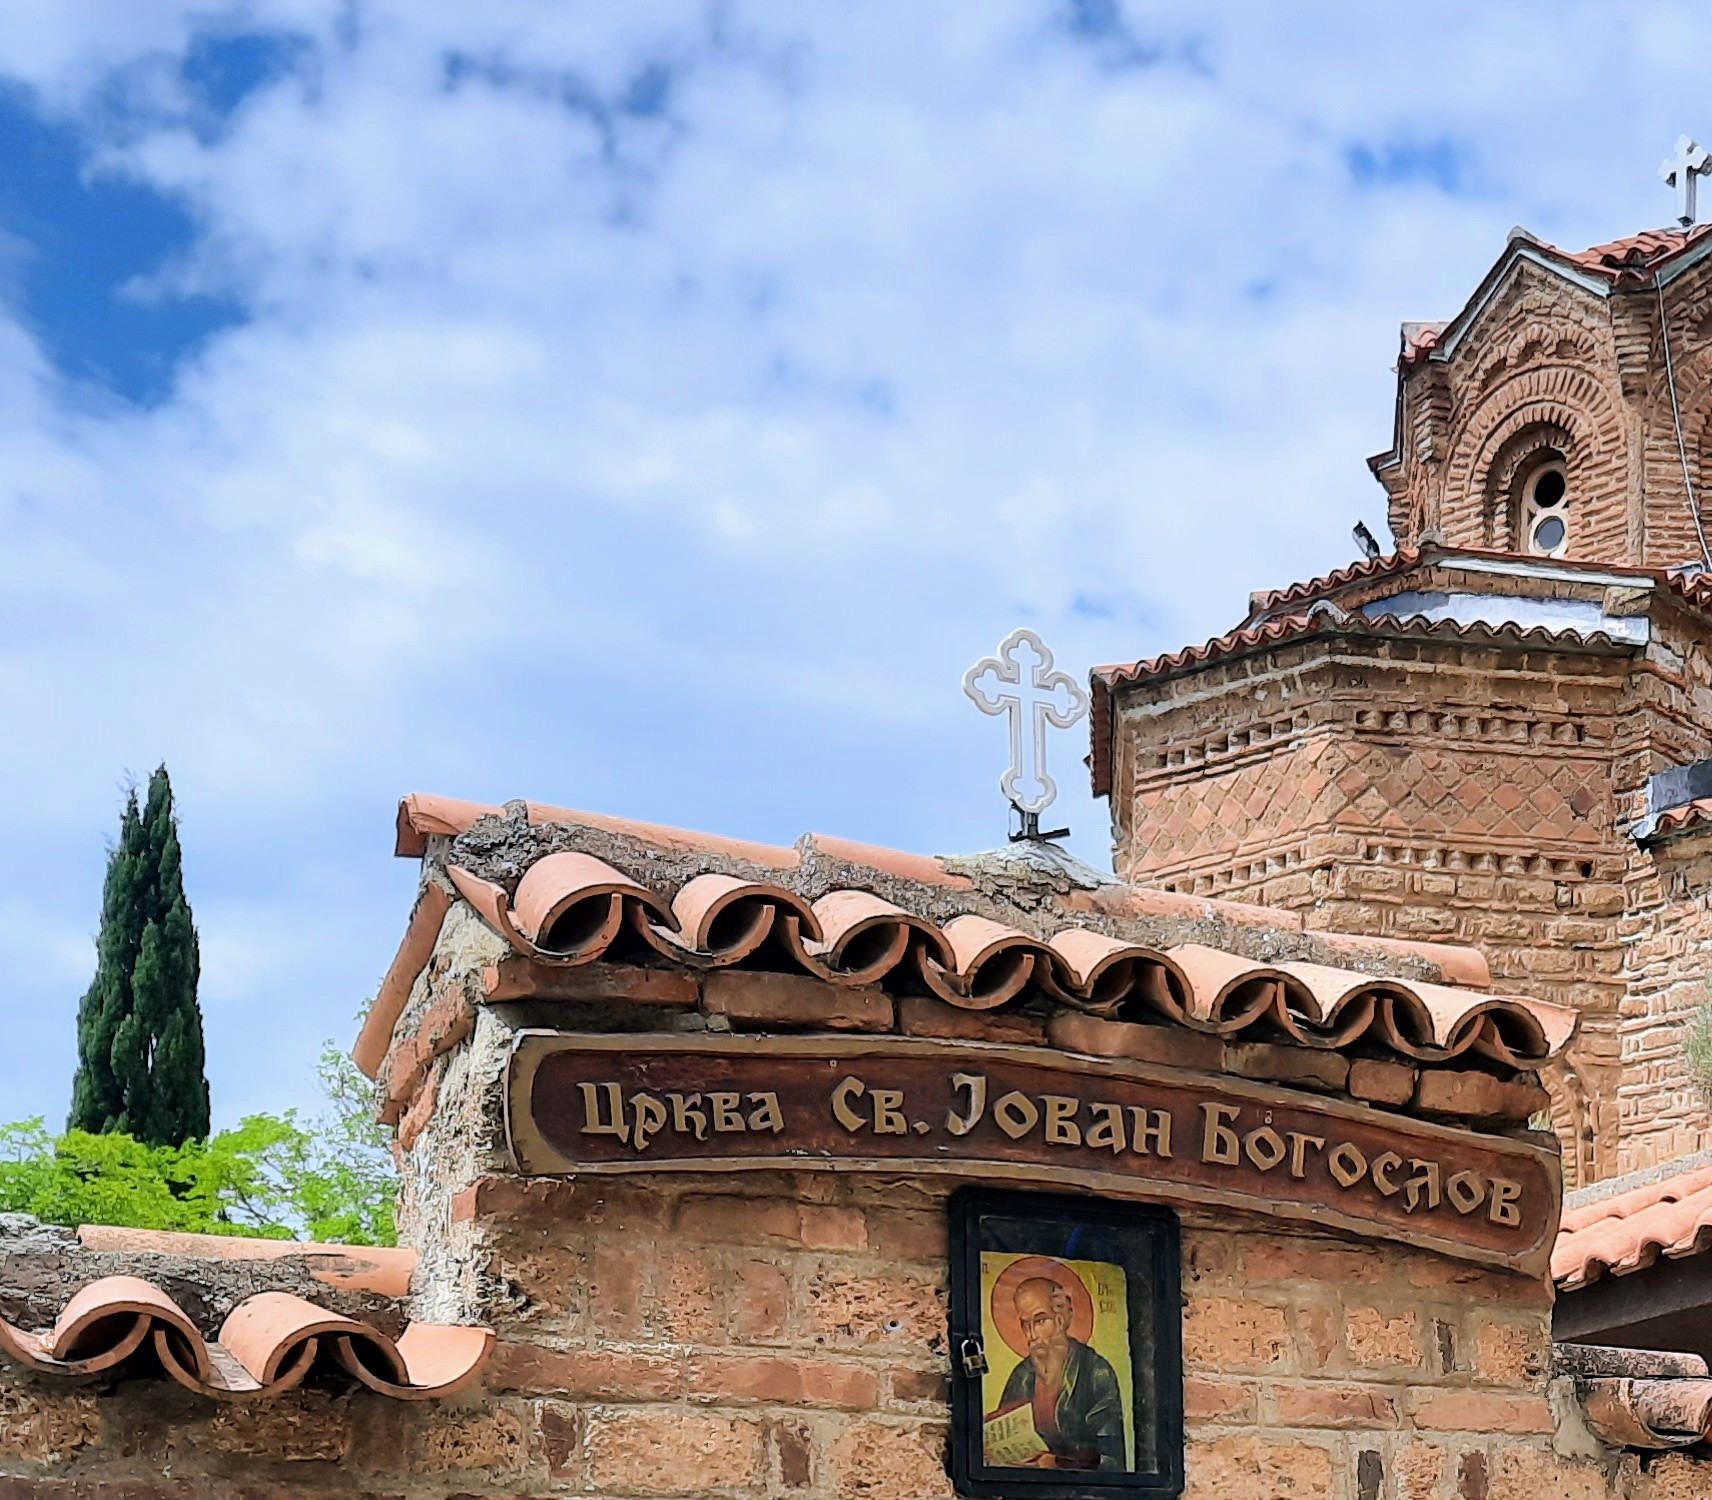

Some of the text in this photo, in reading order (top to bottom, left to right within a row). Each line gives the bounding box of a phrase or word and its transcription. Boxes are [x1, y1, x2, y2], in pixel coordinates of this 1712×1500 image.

[576, 1072, 1523, 1227] Црква Св. Јован Богослов
